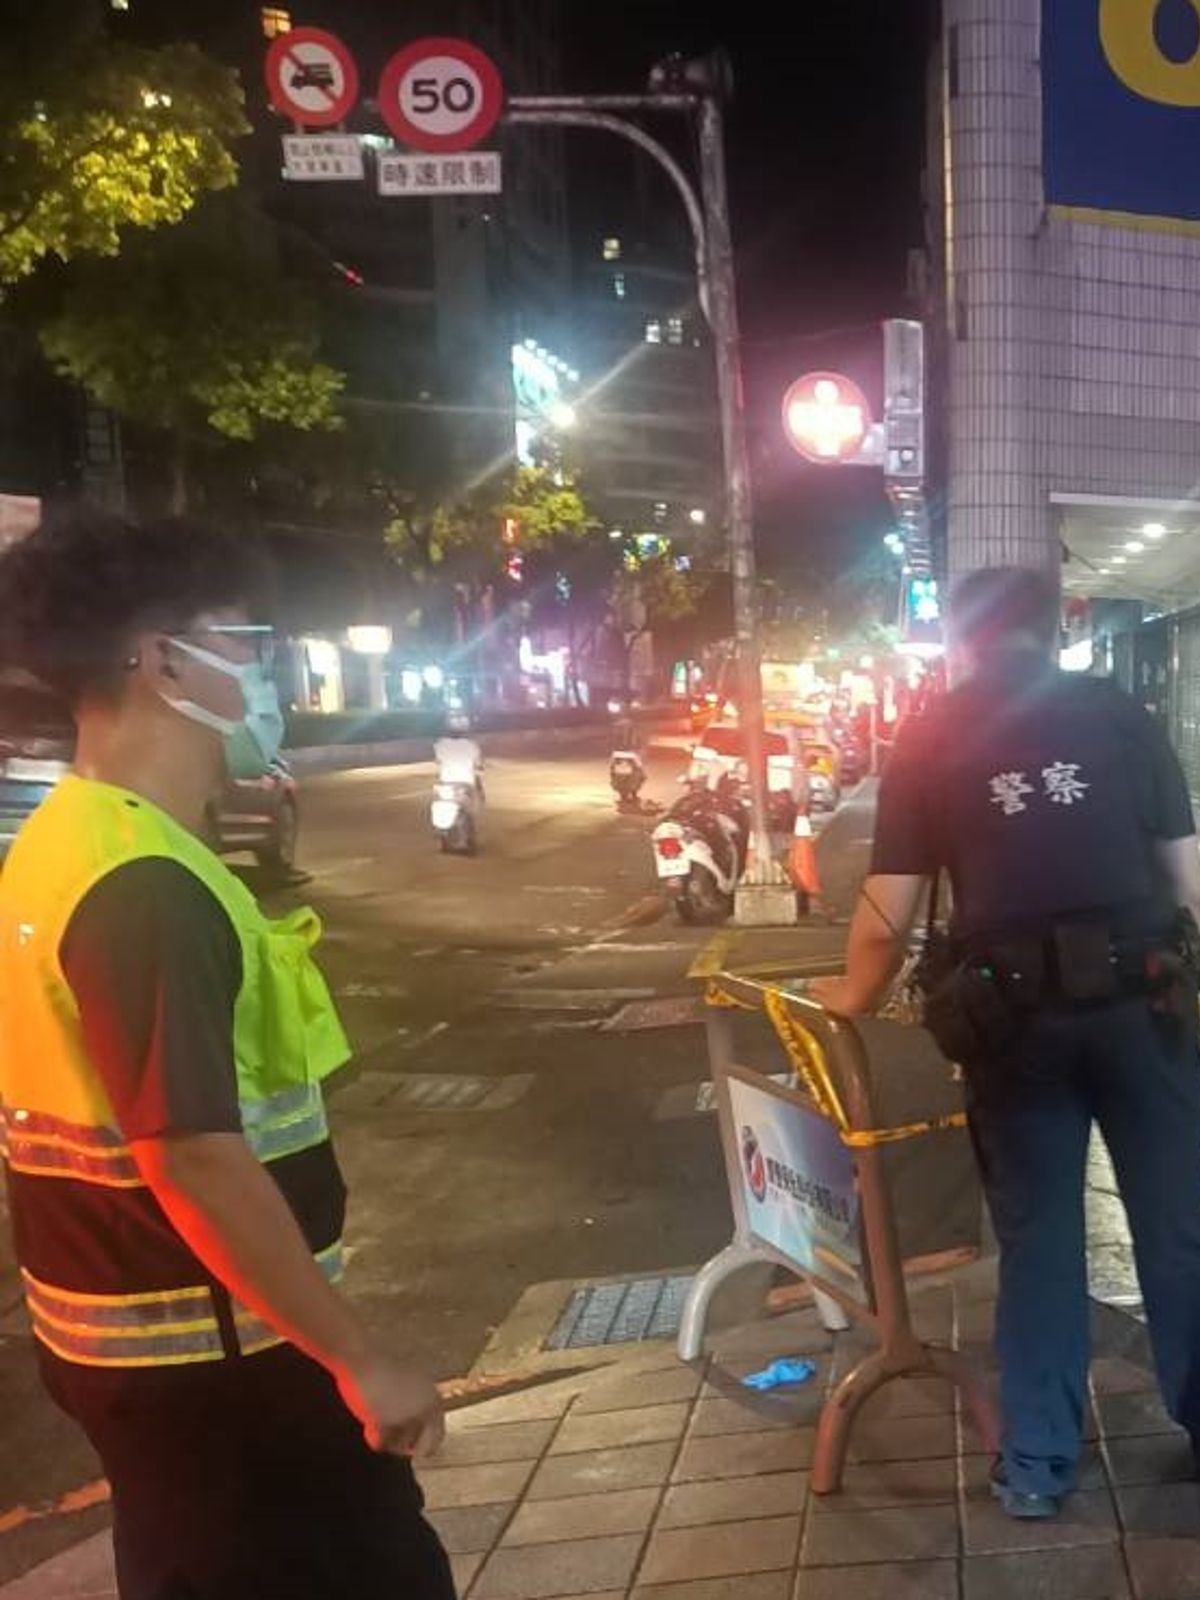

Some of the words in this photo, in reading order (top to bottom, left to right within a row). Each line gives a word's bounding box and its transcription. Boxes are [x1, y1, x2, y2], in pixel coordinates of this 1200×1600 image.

[411, 77, 475, 113] 50
[383, 161, 497, 188] 時速限制
[989, 761, 1090, 814] 警察
